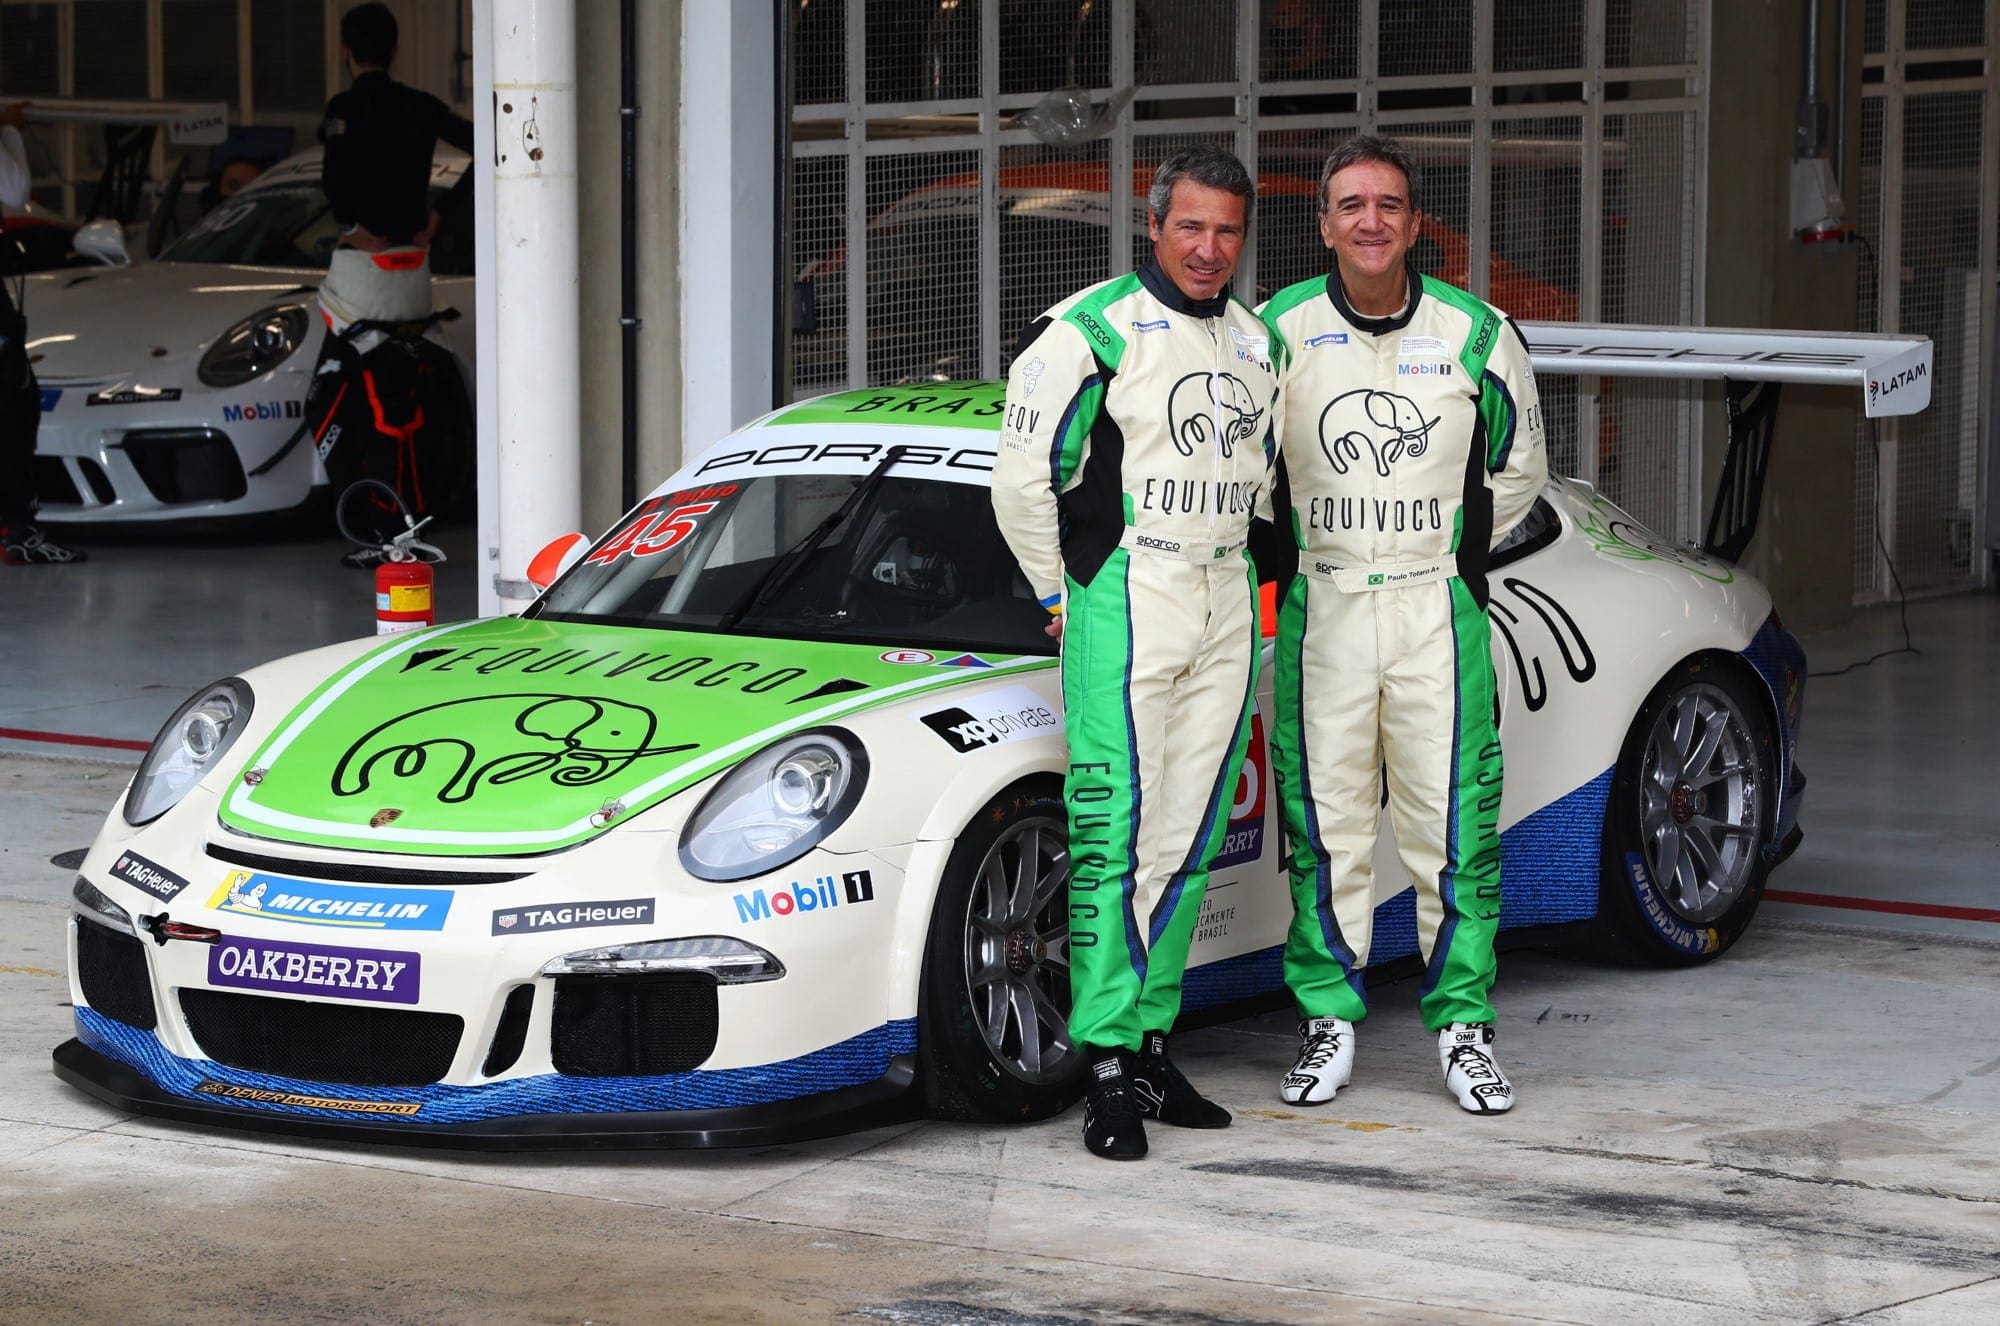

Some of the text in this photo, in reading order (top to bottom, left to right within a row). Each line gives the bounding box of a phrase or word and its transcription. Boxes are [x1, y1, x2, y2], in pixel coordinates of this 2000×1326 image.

[1075, 311, 1111, 346] sparco
[1472, 313, 1496, 356] sparco
[1398, 363, 1437, 376] Mobil
[1881, 362, 1927, 396] LATAM
[222, 402, 281, 422] Mobil
[1007, 403, 1040, 434] EQV
[1006, 441, 1027, 453] BRASIL
[1023, 437, 1033, 446] NO
[1309, 496, 1442, 533] EQUIVOCO
[584, 501, 720, 567] 45
[1136, 534, 1181, 552] sparco
[1387, 573, 1408, 581] Paulo
[1408, 568, 1430, 578] Totaro
[432, 646, 807, 694] EQUIVOCO
[947, 706, 1056, 746] xp private
[1069, 761, 1114, 948] EQUIVOCO
[267, 892, 429, 919] MICHELIN
[733, 875, 839, 924] Mobil
[1632, 862, 1695, 949] MICHELIN
[1198, 924, 1228, 942] BRASIL
[218, 946, 406, 992] OAKBERRY
[1314, 1021, 1335, 1031] OMP
[1455, 1032, 1476, 1042] OMP
[223, 1086, 416, 1114] DENER MOTORSPORT
